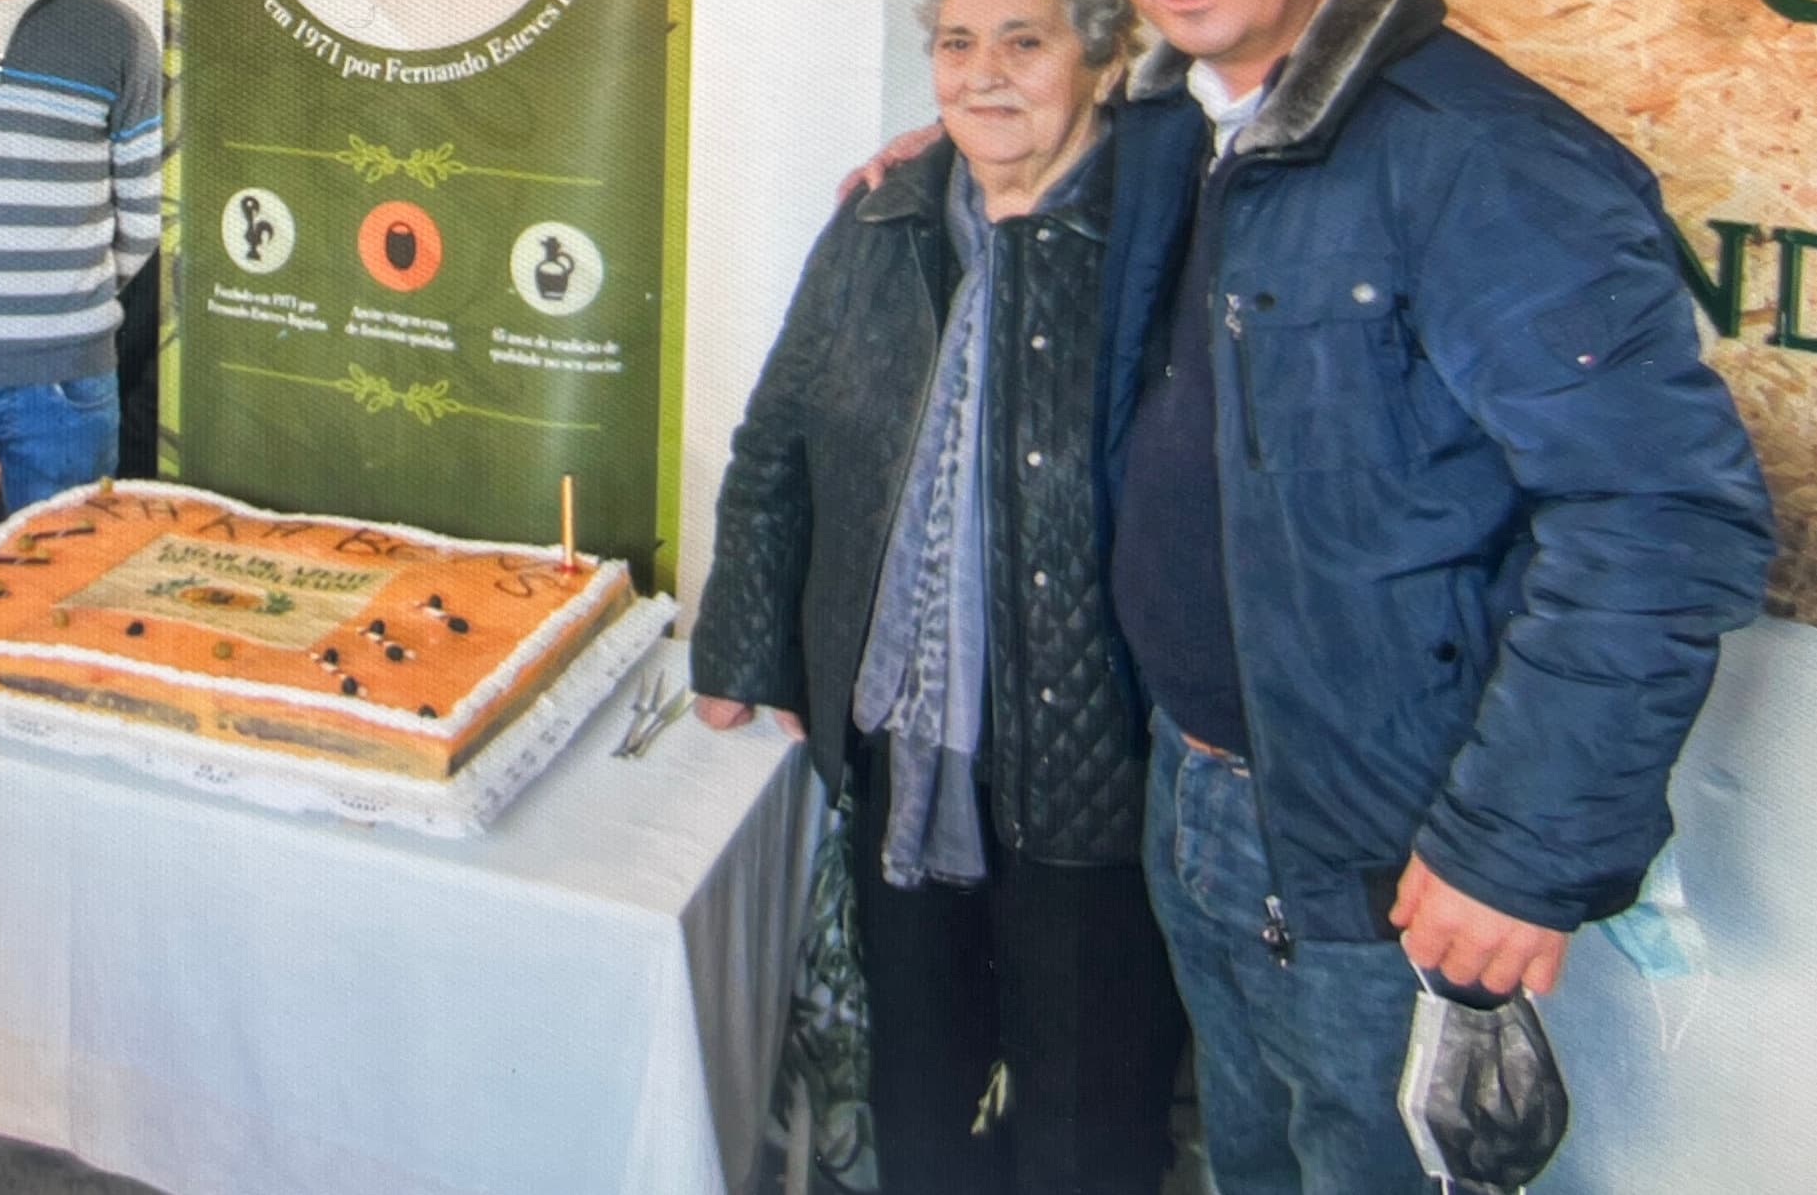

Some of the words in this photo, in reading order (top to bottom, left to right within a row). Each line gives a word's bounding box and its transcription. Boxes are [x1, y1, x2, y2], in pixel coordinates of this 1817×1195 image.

[293, 19, 341, 65] 1971
[342, 55, 382, 79] por
[385, 51, 488, 85] Fernando
[486, 4, 561, 66] Esteves
